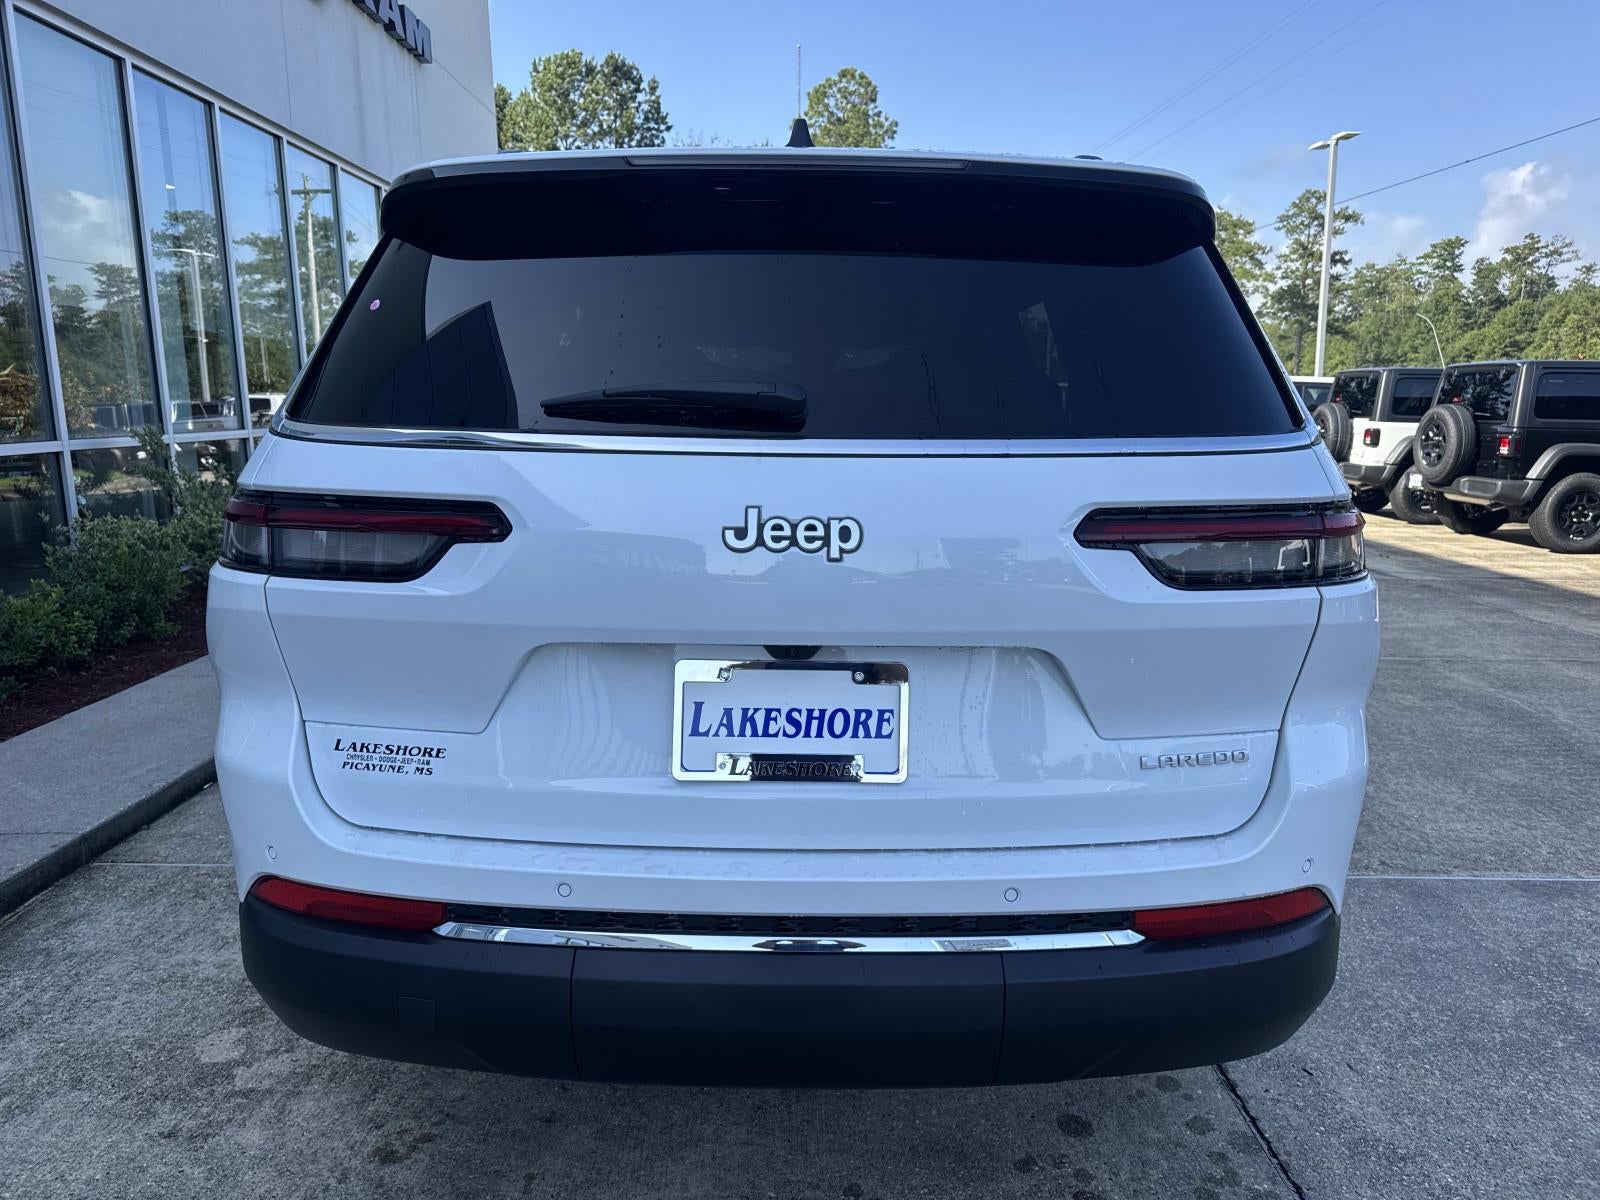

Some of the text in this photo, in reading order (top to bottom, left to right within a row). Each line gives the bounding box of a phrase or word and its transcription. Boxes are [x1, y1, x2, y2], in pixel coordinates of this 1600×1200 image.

[351, 0, 432, 63] AM
[722, 505, 864, 562] Jeep
[688, 701, 895, 740] LAKESHORE
[334, 738, 447, 759] LAKESHORE
[342, 761, 434, 776] PICAYUNE, MS
[728, 757, 855, 778] LAKESHORE
[1140, 749, 1249, 770] LAREDO
